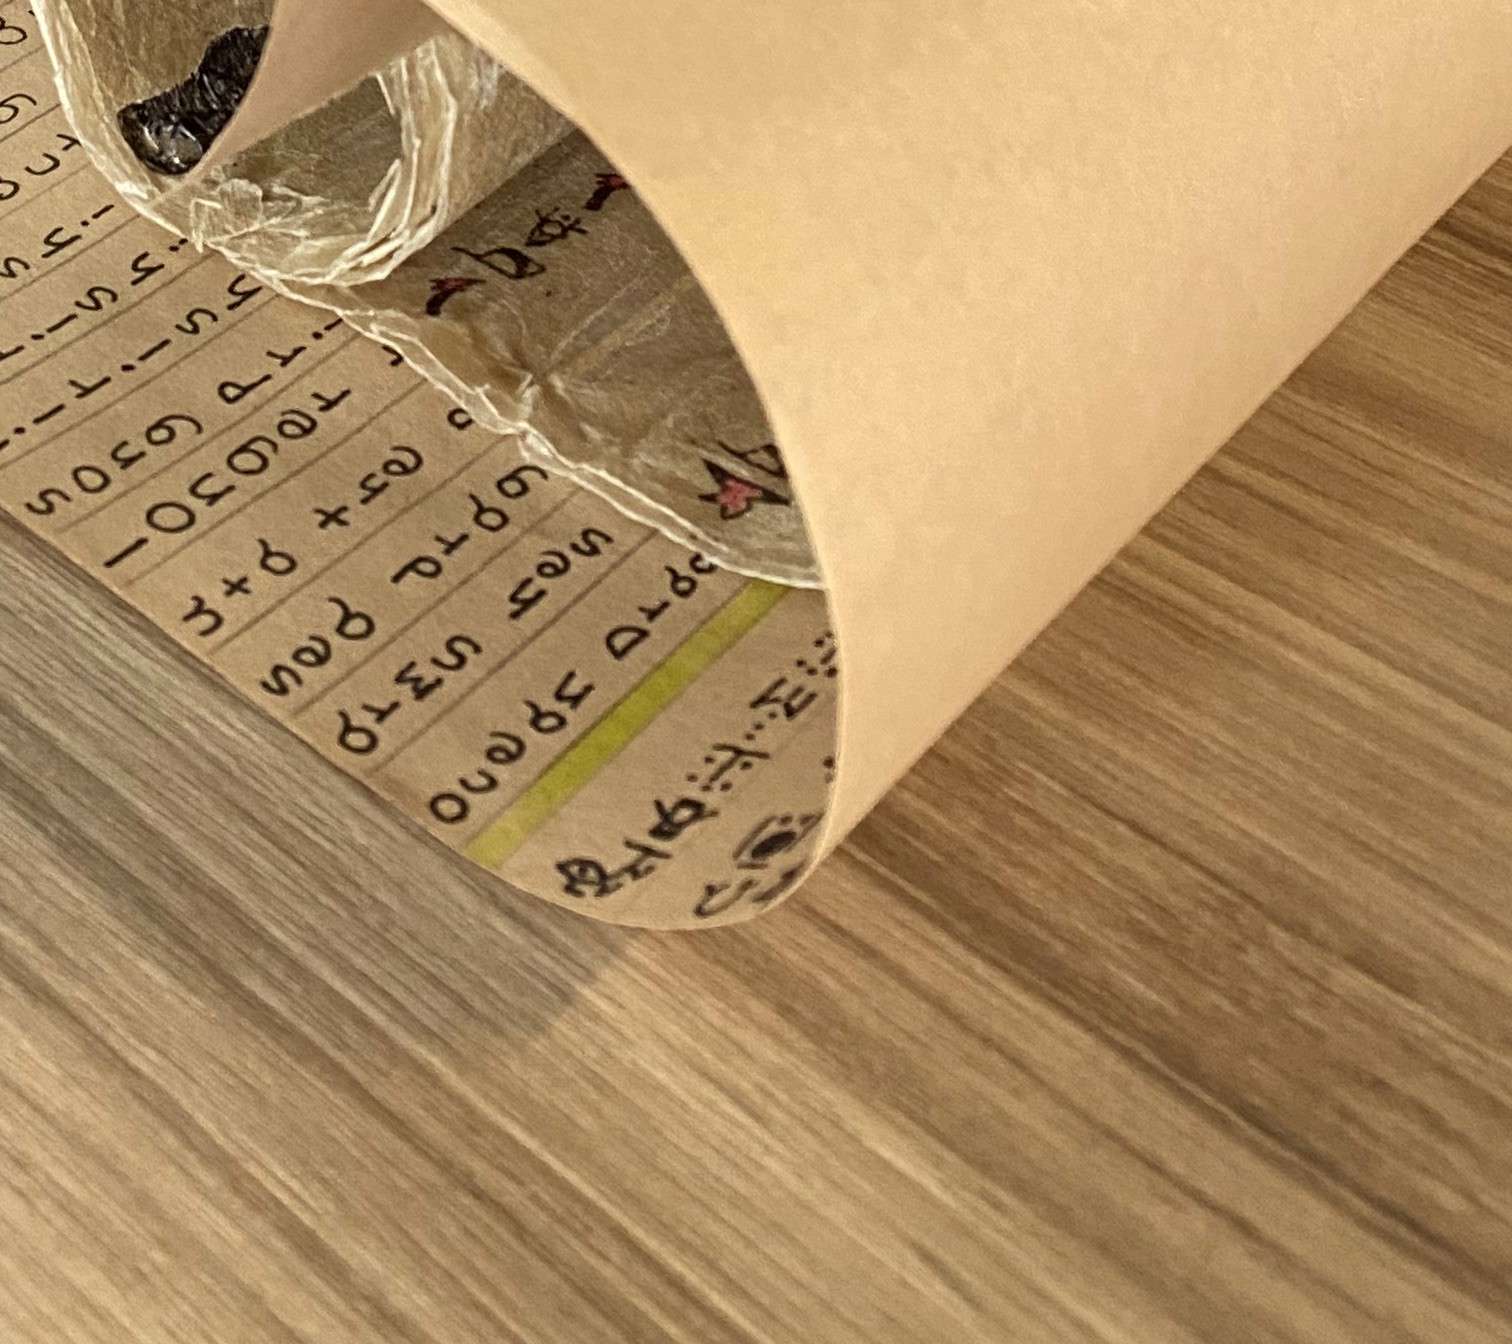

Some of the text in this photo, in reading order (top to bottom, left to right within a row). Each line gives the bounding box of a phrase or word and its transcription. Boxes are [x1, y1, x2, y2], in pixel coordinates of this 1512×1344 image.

[24, 414, 204, 516] song
[103, 388, 352, 569] longer
[313, 445, 424, 530] the
[259, 596, 376, 697] sea
[337, 635, 483, 755] arms
